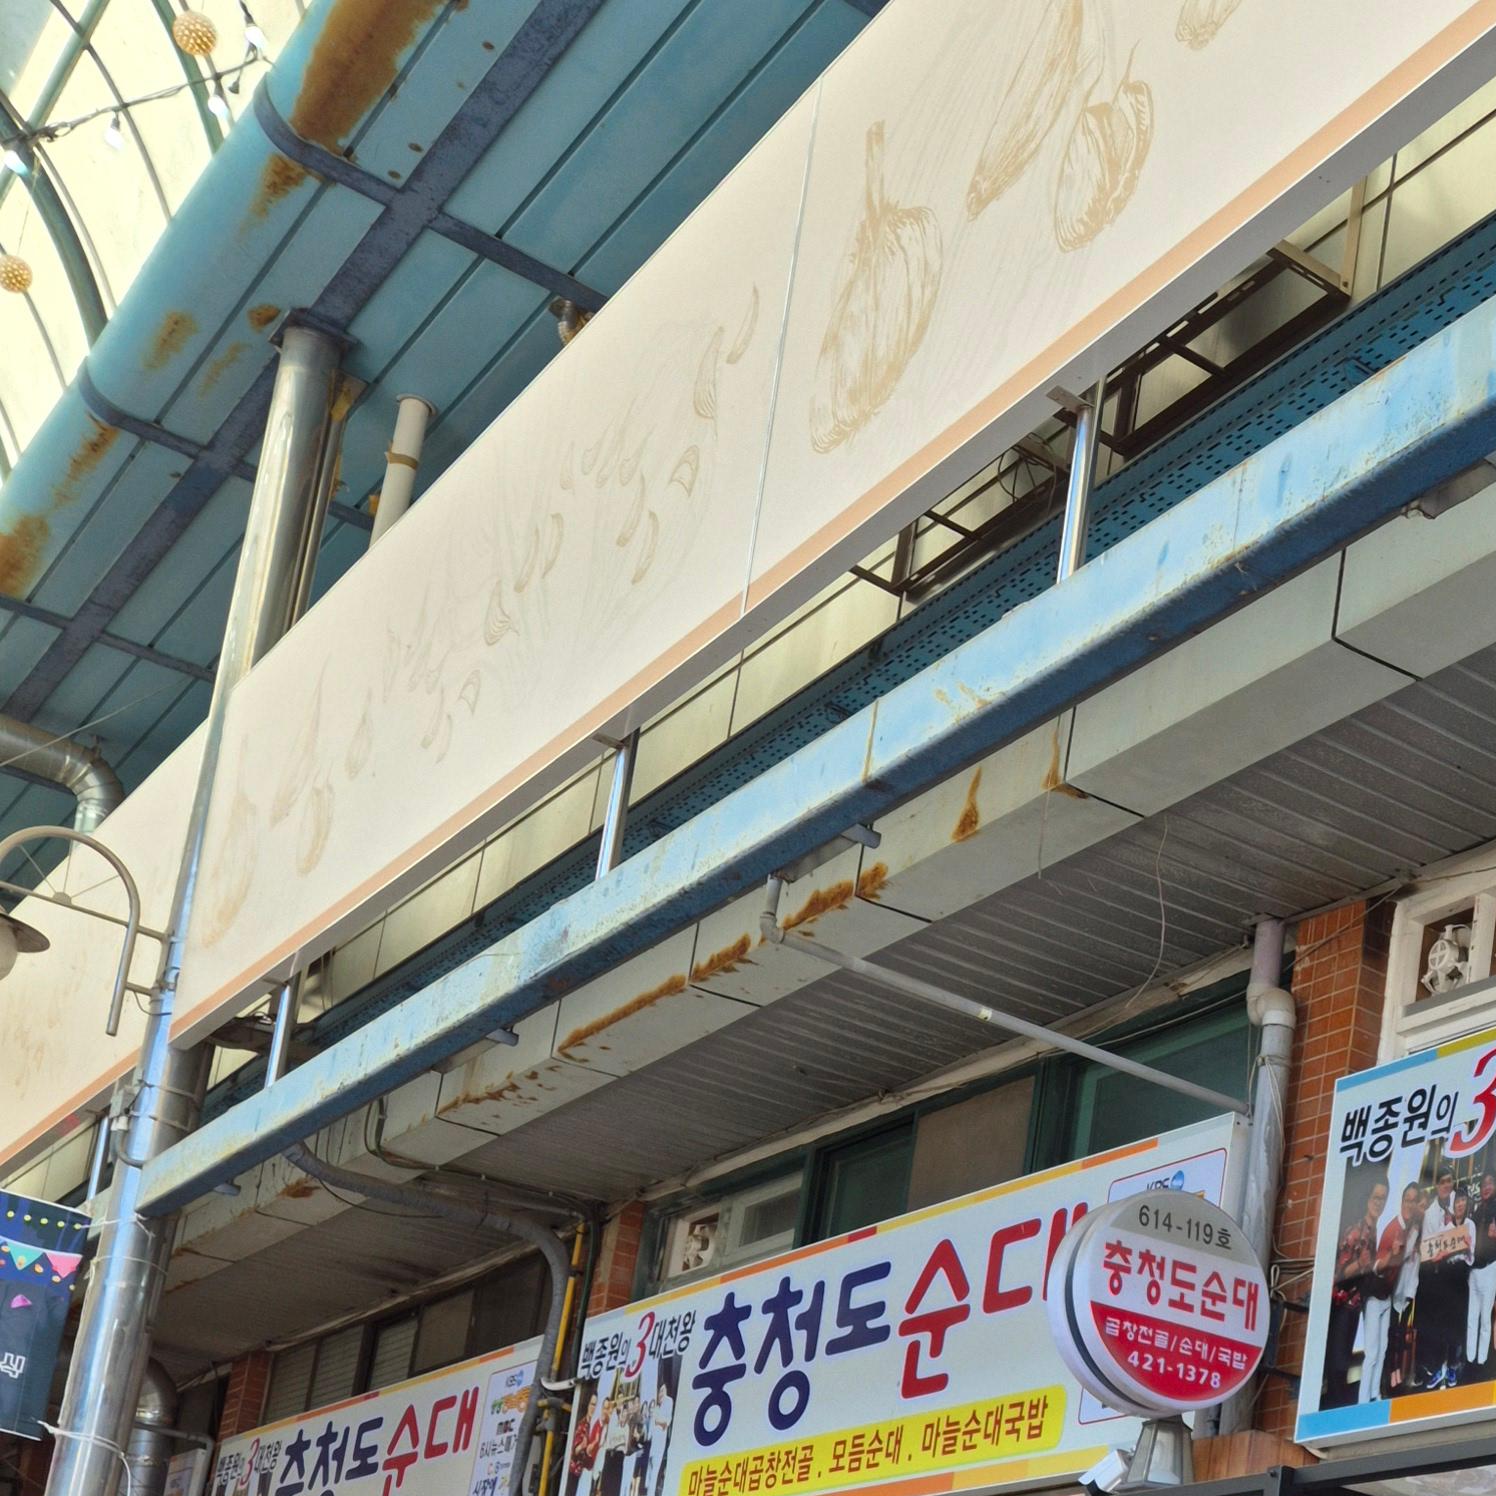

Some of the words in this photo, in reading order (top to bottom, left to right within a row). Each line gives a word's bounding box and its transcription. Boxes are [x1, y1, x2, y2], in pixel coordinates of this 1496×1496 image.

[1339, 1085, 1459, 1165] 백종원의
[1139, 1205, 1231, 1250] 614-119호
[1103, 1240, 1259, 1331] 충청도순대
[581, 1332, 631, 1377] 백종원의
[625, 1310, 696, 1377] 3대천왕
[1128, 1351, 1221, 1388] 421-1378
[829, 1425, 903, 1473] 모듬순대
[922, 1395, 1048, 1458] 마늘순대국밥
